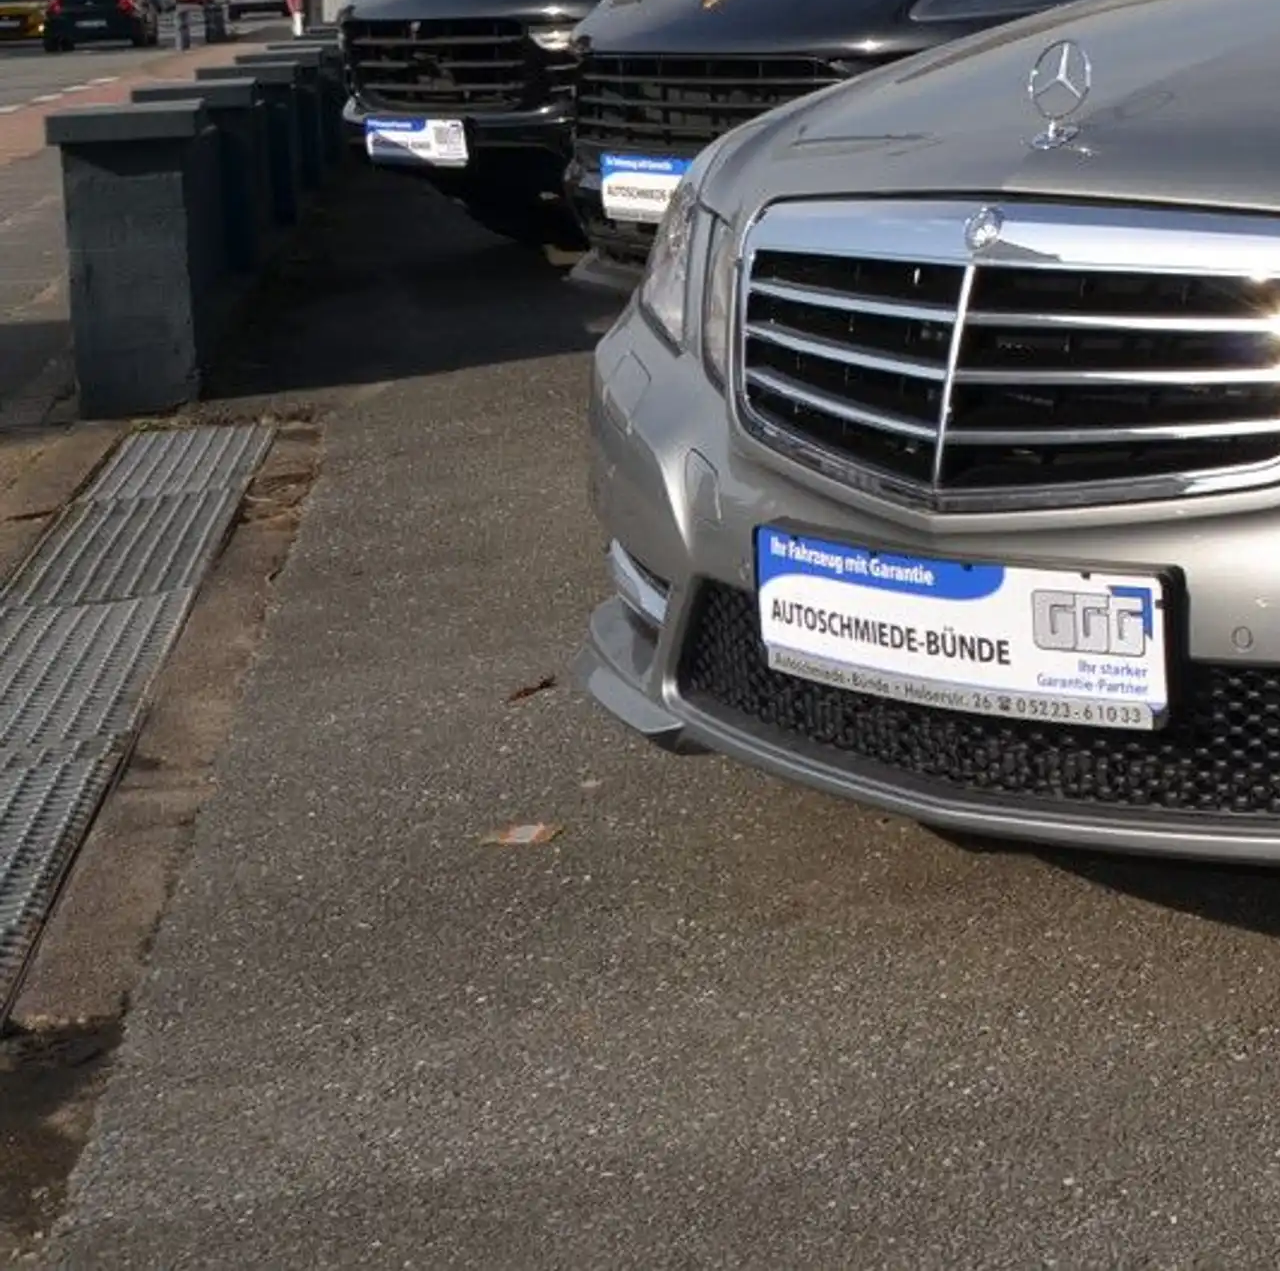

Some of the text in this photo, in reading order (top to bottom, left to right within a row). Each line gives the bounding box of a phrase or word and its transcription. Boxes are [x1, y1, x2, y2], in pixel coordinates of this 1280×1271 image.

[769, 536, 935, 586] Ihr Fahrzeug mit Garantie
[771, 598, 1012, 665] AUTOSCHMIEDE-BÜNDE
[1077, 659, 1149, 678] Ihr starker
[973, 692, 992, 711] 26
